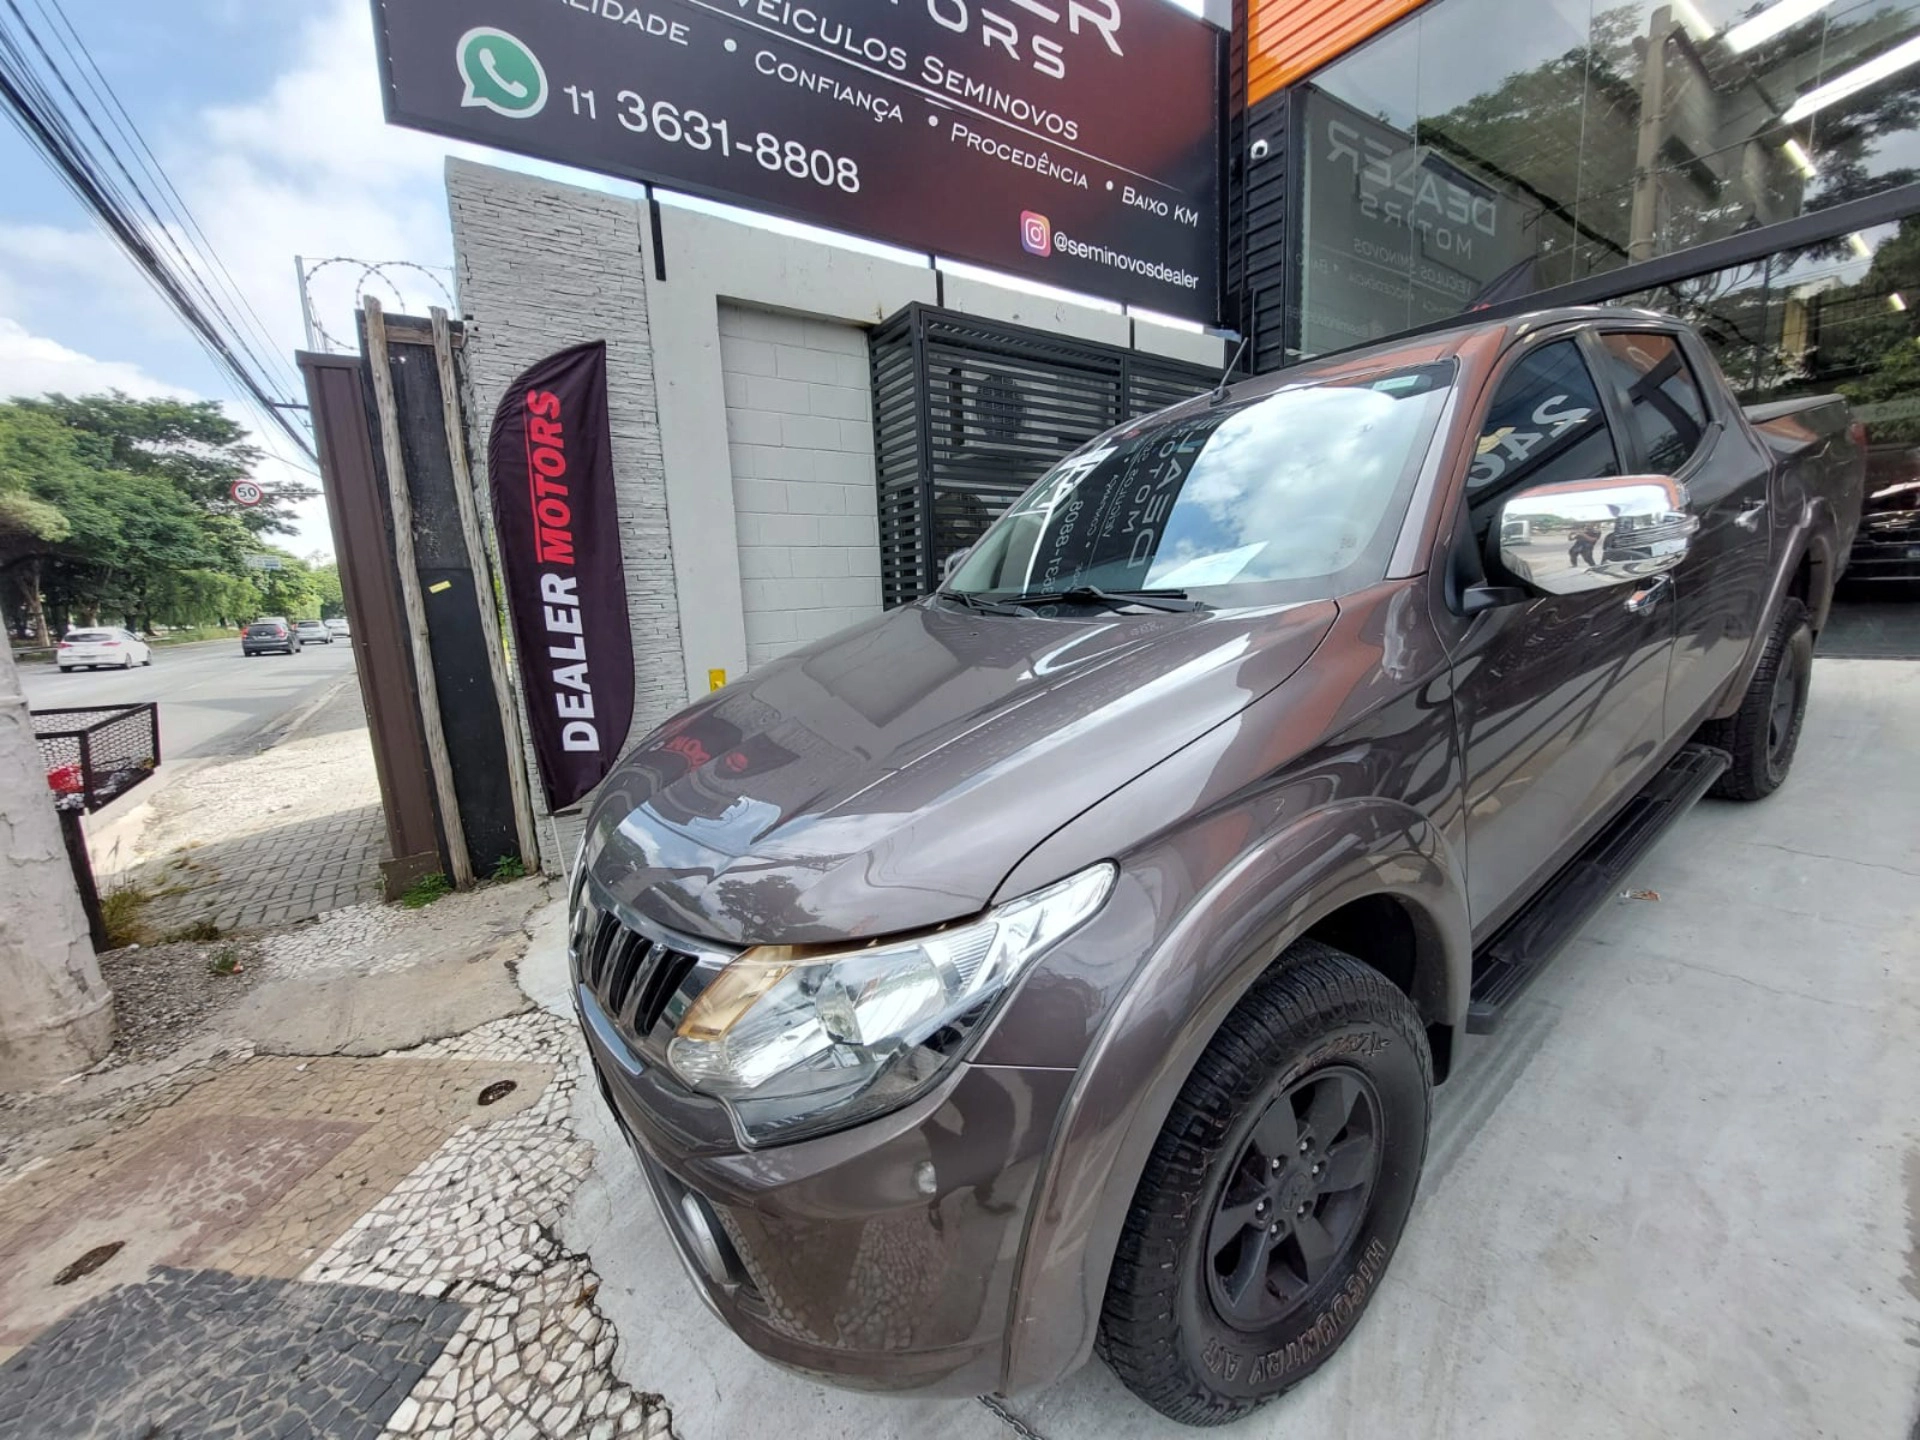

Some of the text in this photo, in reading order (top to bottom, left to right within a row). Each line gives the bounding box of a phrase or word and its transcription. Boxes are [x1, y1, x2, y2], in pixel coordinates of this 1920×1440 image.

[563, 85, 860, 194] 11 3631-8808
[755, 51, 903, 123] CONFIANÇA
[951, 122, 1089, 190] PROCEDÊNCIA
[1121, 186, 1169, 217] BAIXO
[1174, 205, 1199, 228] KM
[921, 55, 1079, 141] SEMINOVOS
[1053, 231, 1200, 290] @seminovosdealer
[238, 486, 257, 498] 50
[527, 388, 600, 752] DEALER MOTORS
